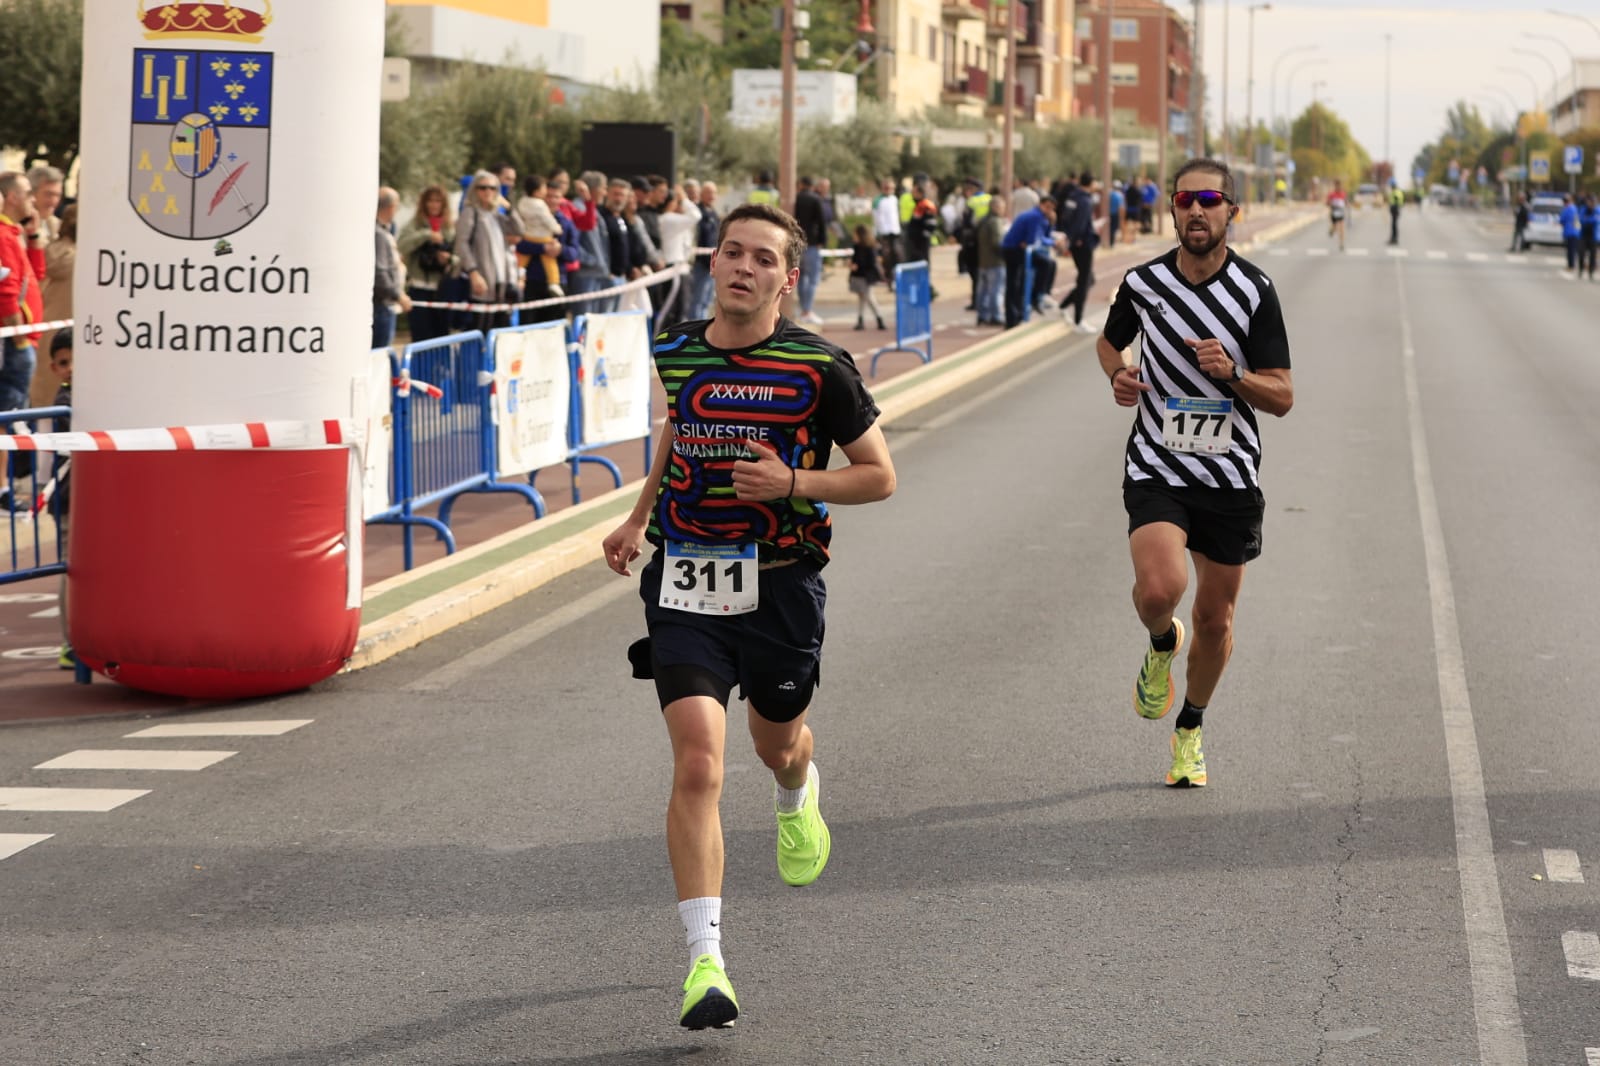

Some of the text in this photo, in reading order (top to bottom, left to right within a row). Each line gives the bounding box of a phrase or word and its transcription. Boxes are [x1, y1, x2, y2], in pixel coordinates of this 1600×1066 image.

[97, 249, 309, 298] Diputación
[84, 309, 325, 354] de Salamanca
[709, 383, 774, 402] XXXVIII
[681, 423, 769, 441] SILVESTRE
[1172, 412, 1226, 437] 177
[673, 559, 743, 593] 311
